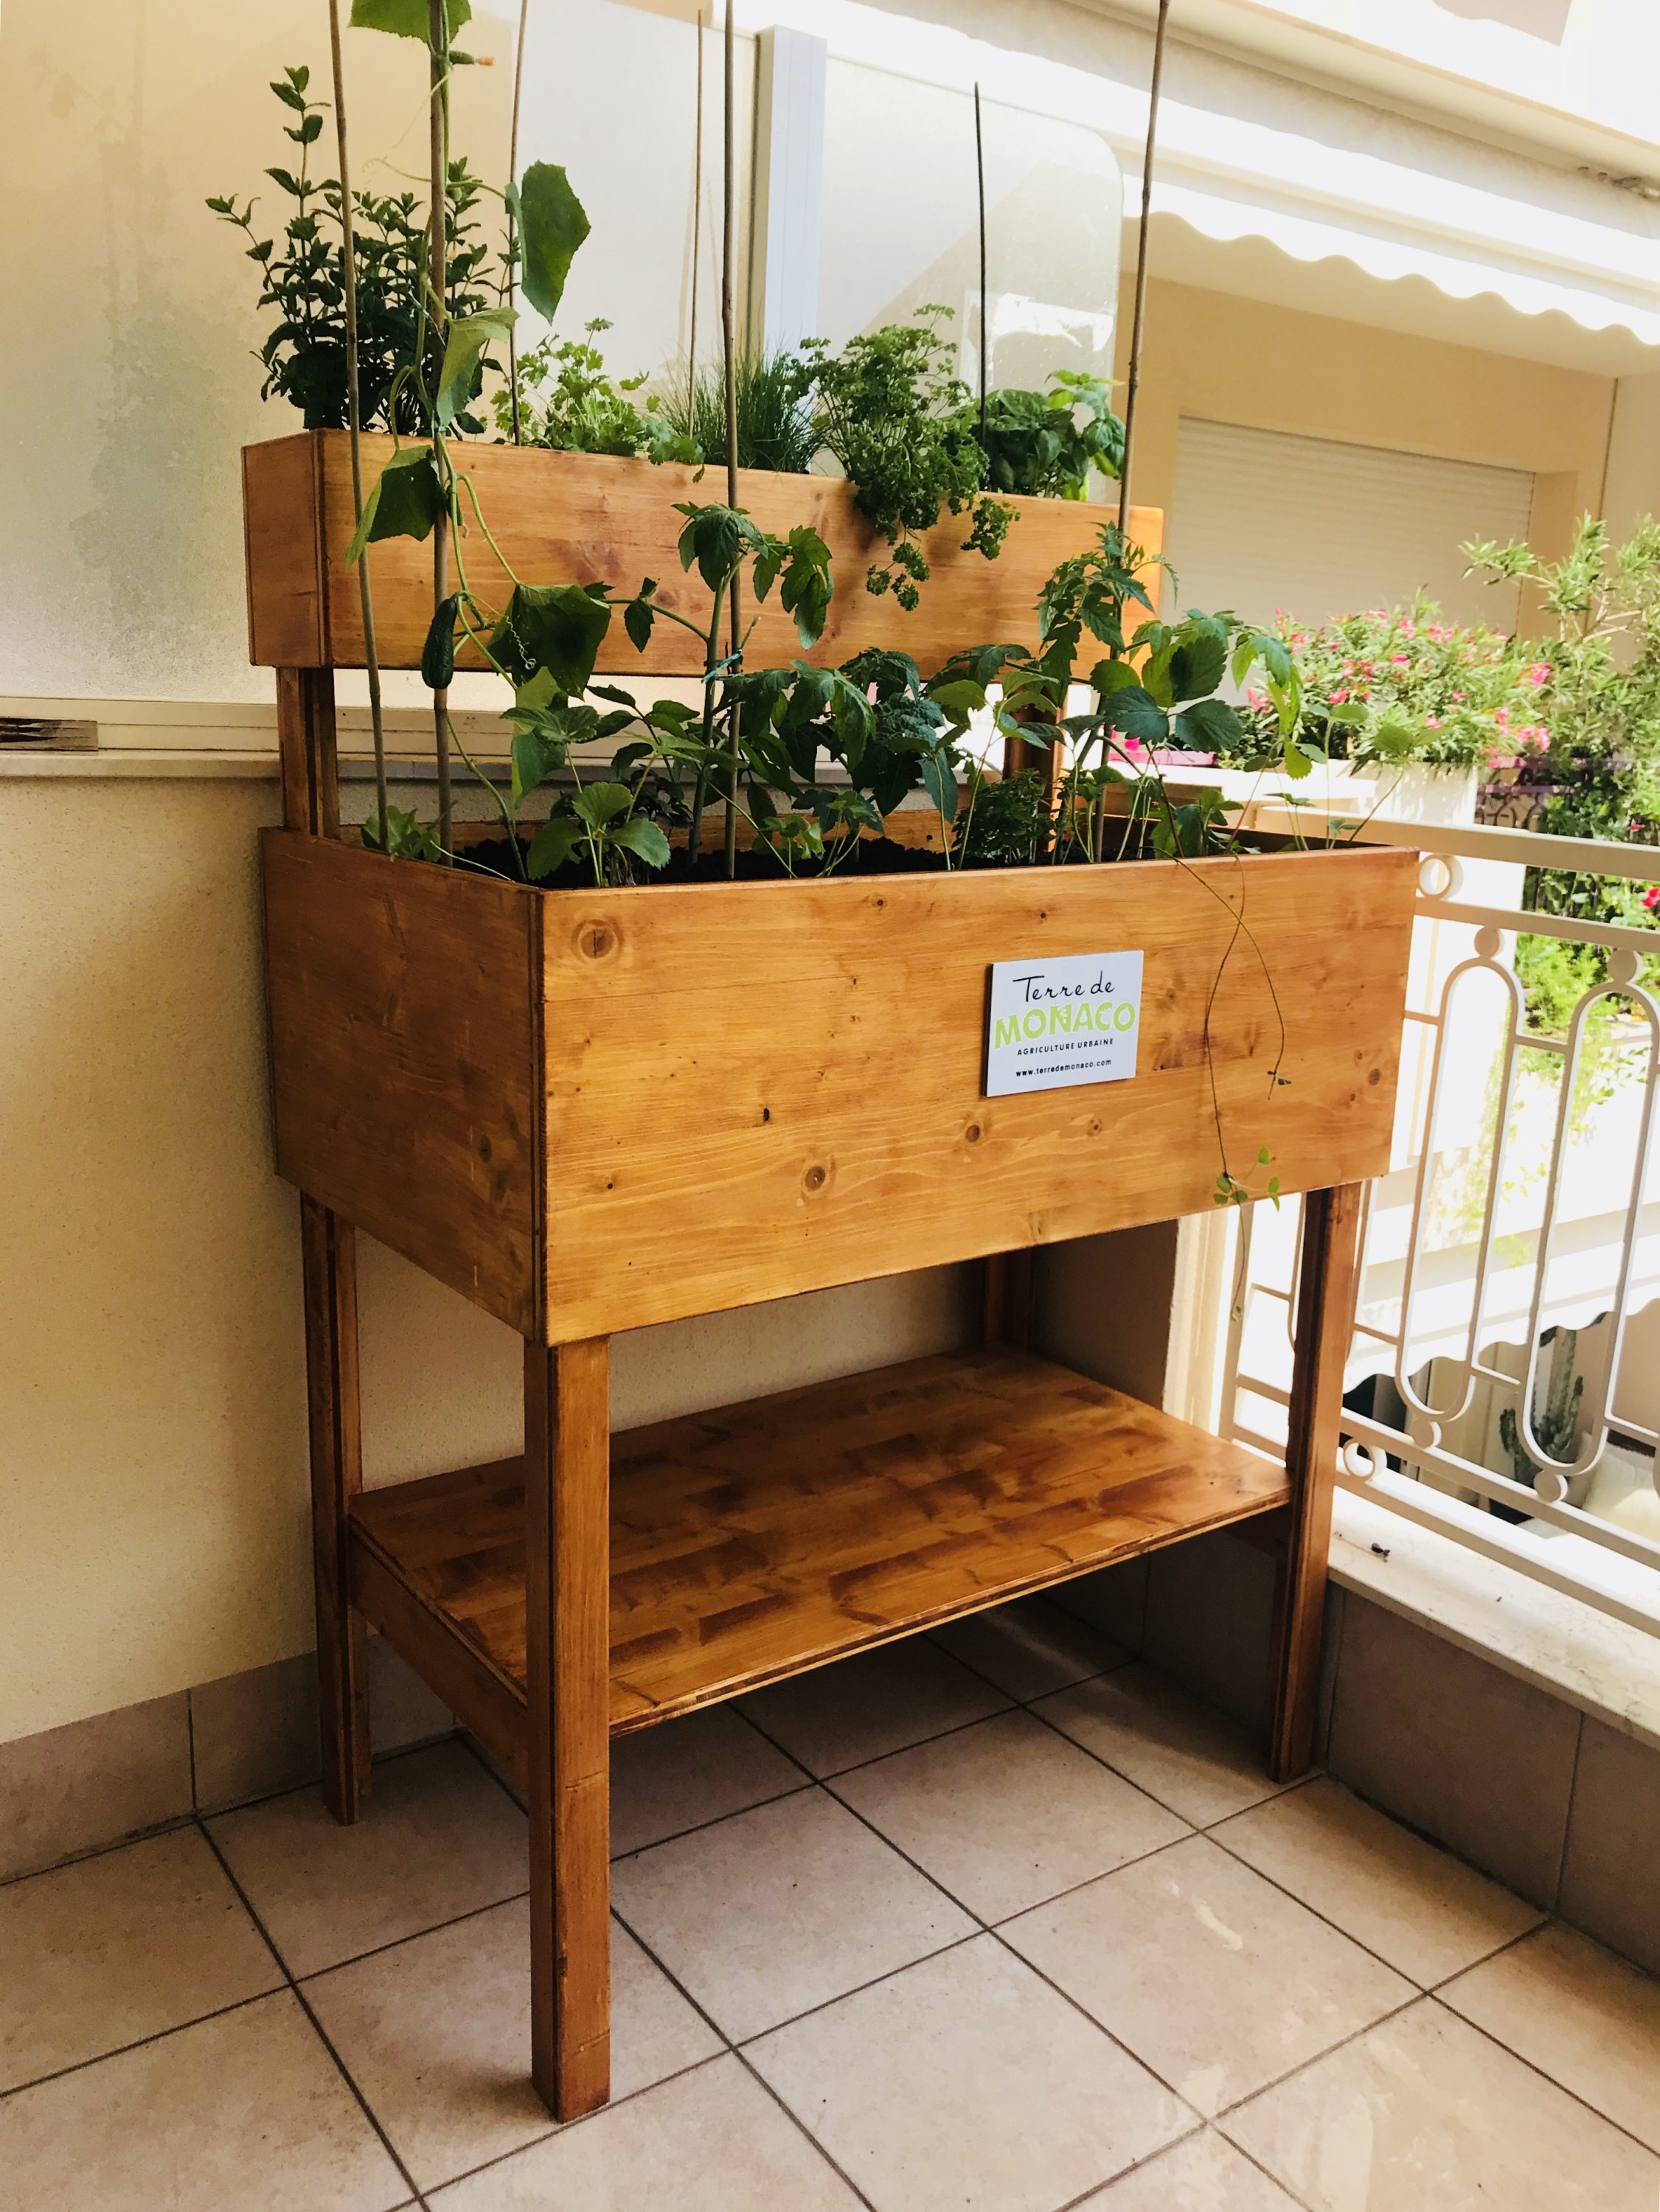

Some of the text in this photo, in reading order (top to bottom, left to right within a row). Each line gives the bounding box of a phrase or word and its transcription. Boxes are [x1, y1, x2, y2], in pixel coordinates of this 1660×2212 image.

[1013, 970, 1115, 1003] Terre de
[994, 1001, 1136, 1050] MONACO
[1017, 1038, 1114, 1056] AGRICULTURE URBAINE
[1015, 1059, 1112, 1077] www.terredemonaco.com
